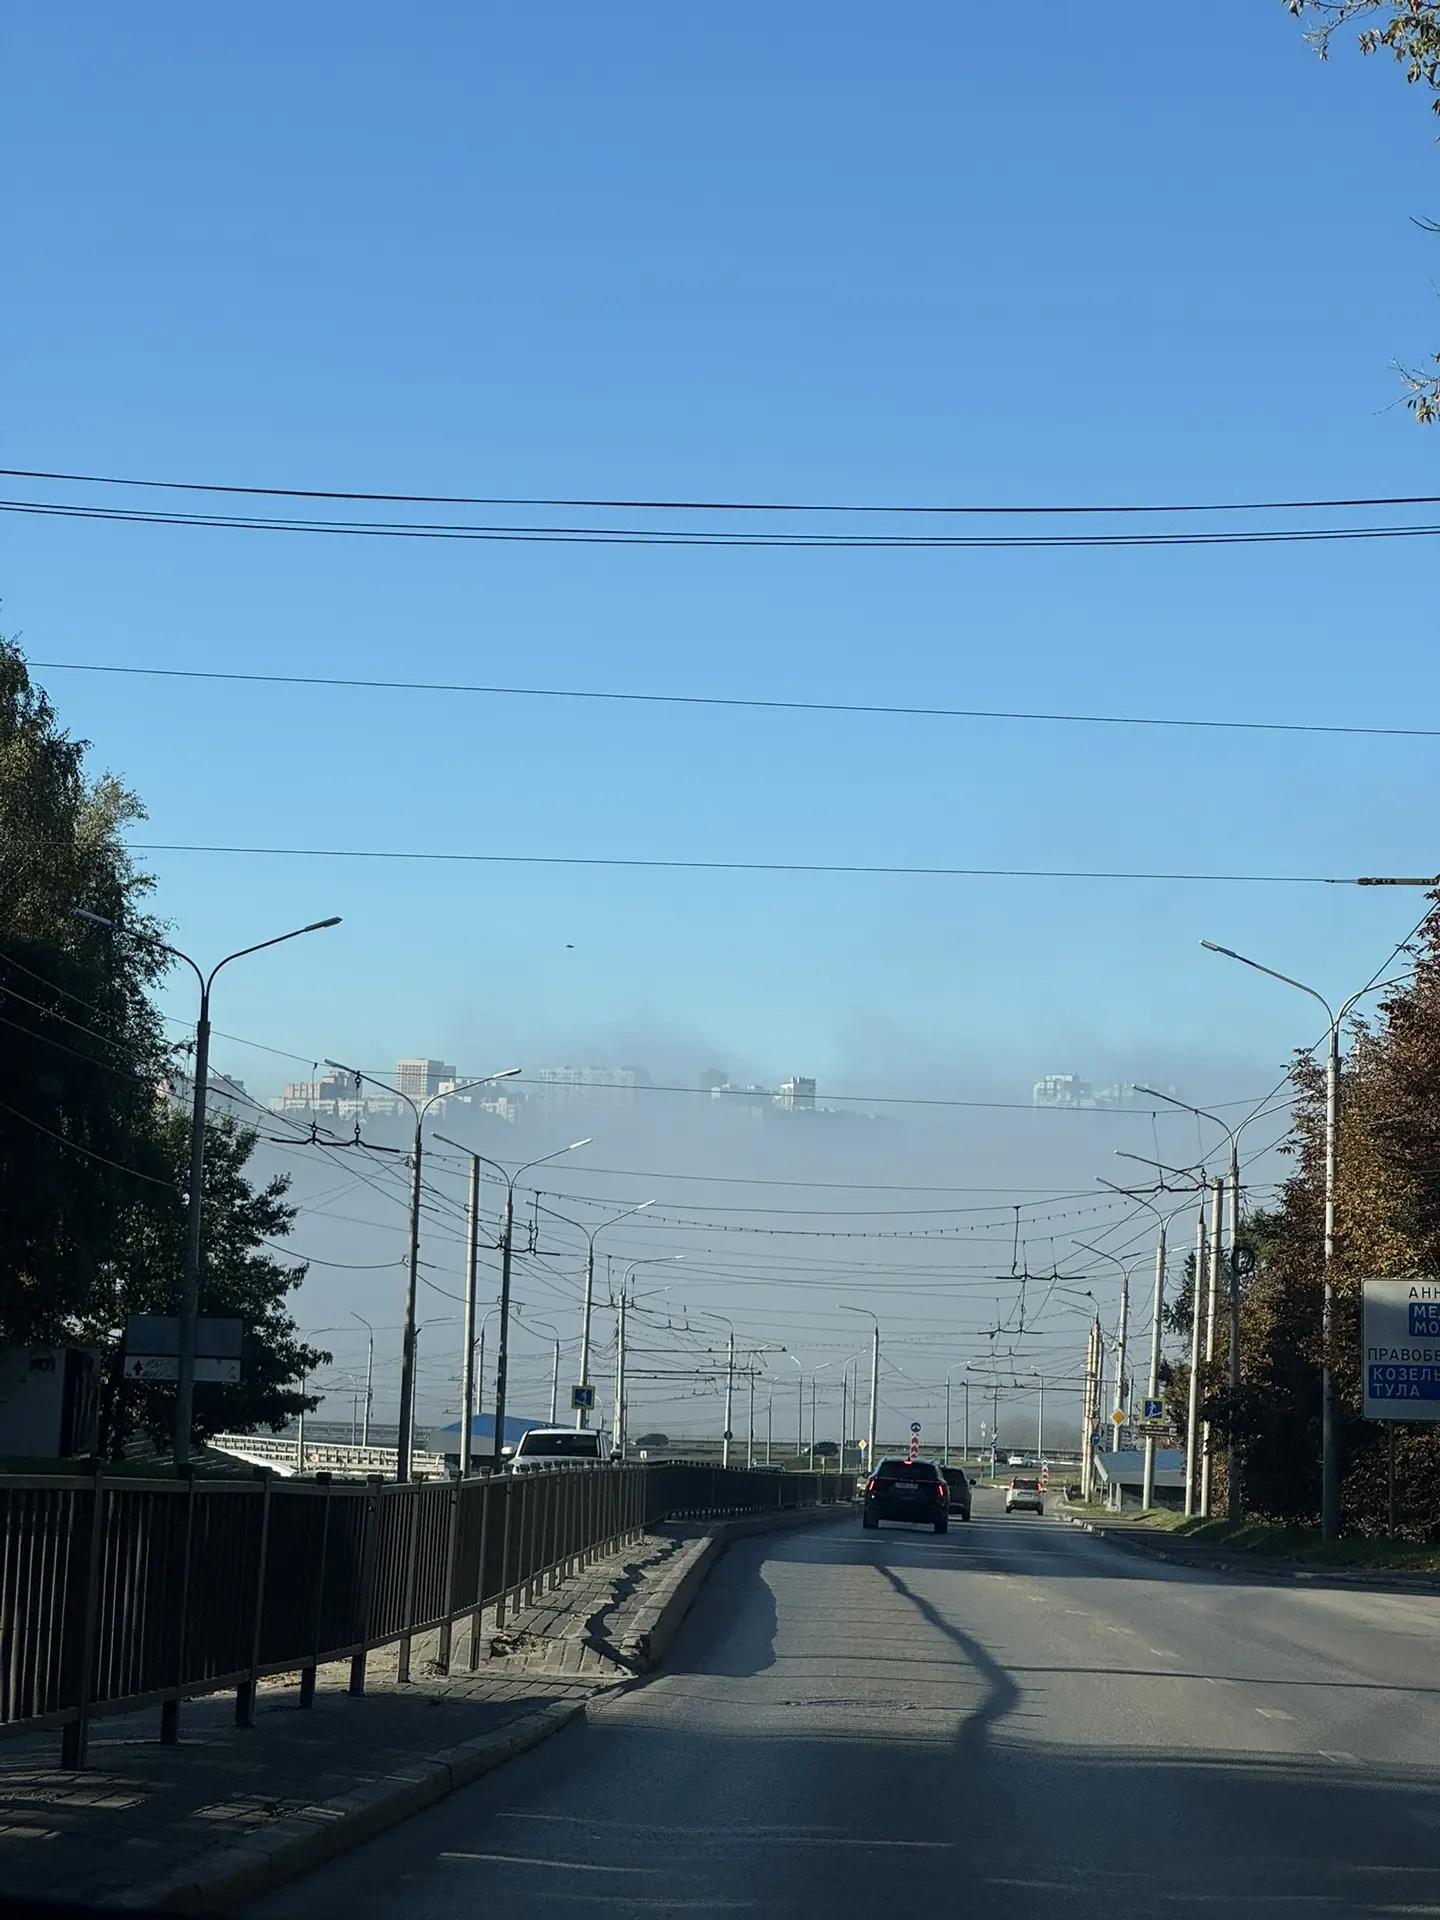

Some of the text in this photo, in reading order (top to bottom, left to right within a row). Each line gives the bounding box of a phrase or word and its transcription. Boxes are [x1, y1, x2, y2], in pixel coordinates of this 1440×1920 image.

[1409, 1287, 1440, 1298] АНН
[1414, 1305, 1440, 1319] МЕ
[1373, 1383, 1420, 1397] ТУЛА
